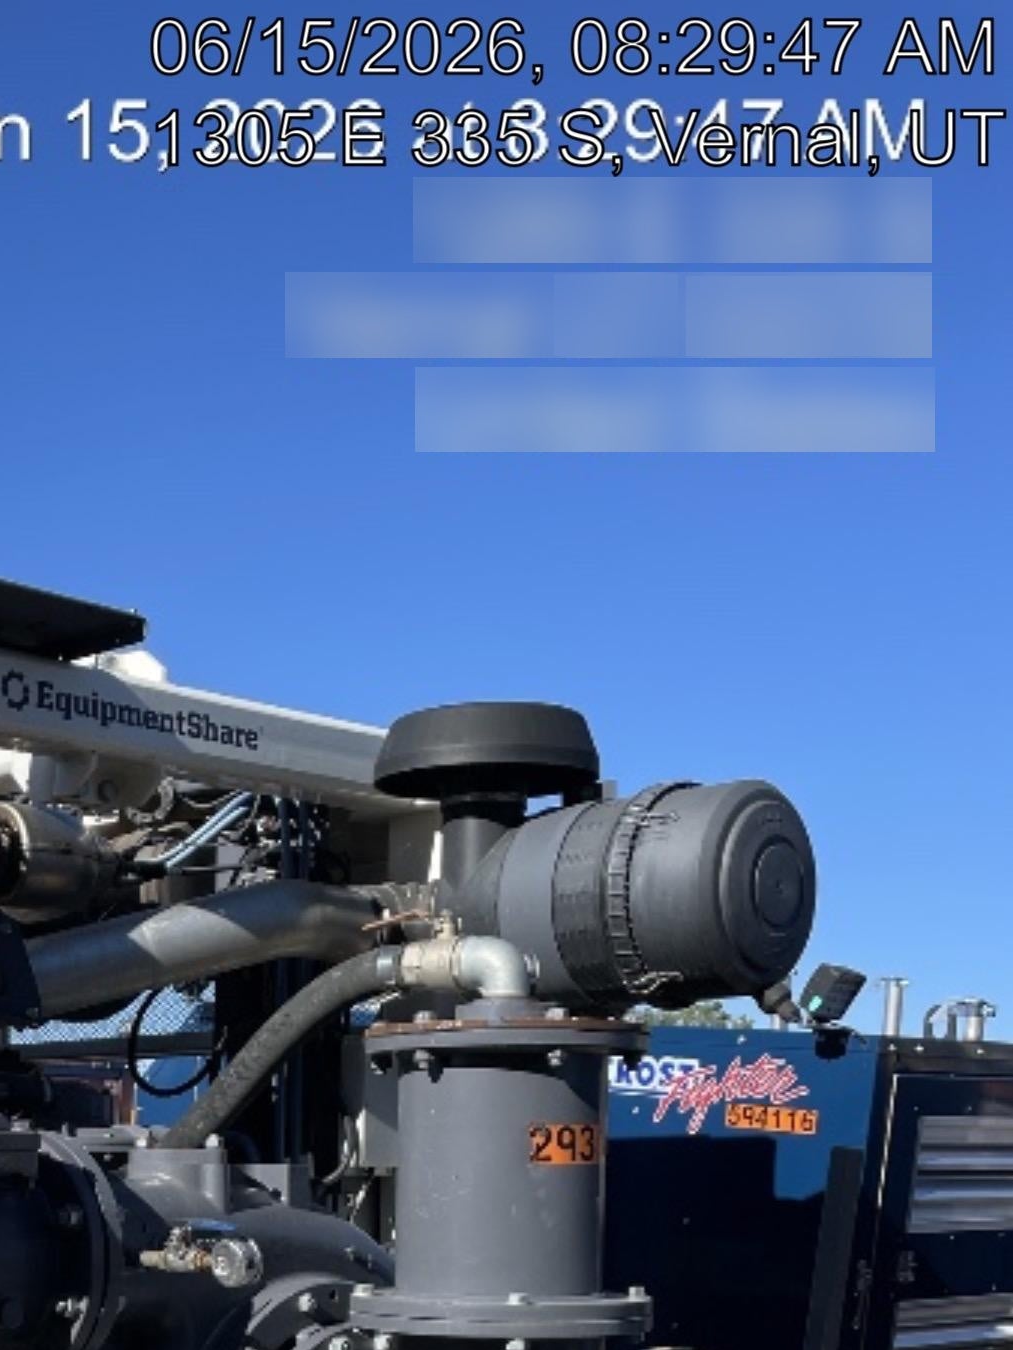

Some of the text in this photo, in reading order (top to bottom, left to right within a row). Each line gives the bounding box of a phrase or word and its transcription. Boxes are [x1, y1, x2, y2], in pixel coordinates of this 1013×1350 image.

[36, 680, 259, 750] EquipmentShare
[609, 1057, 700, 1088] ROST
[529, 1125, 594, 1163] 293
